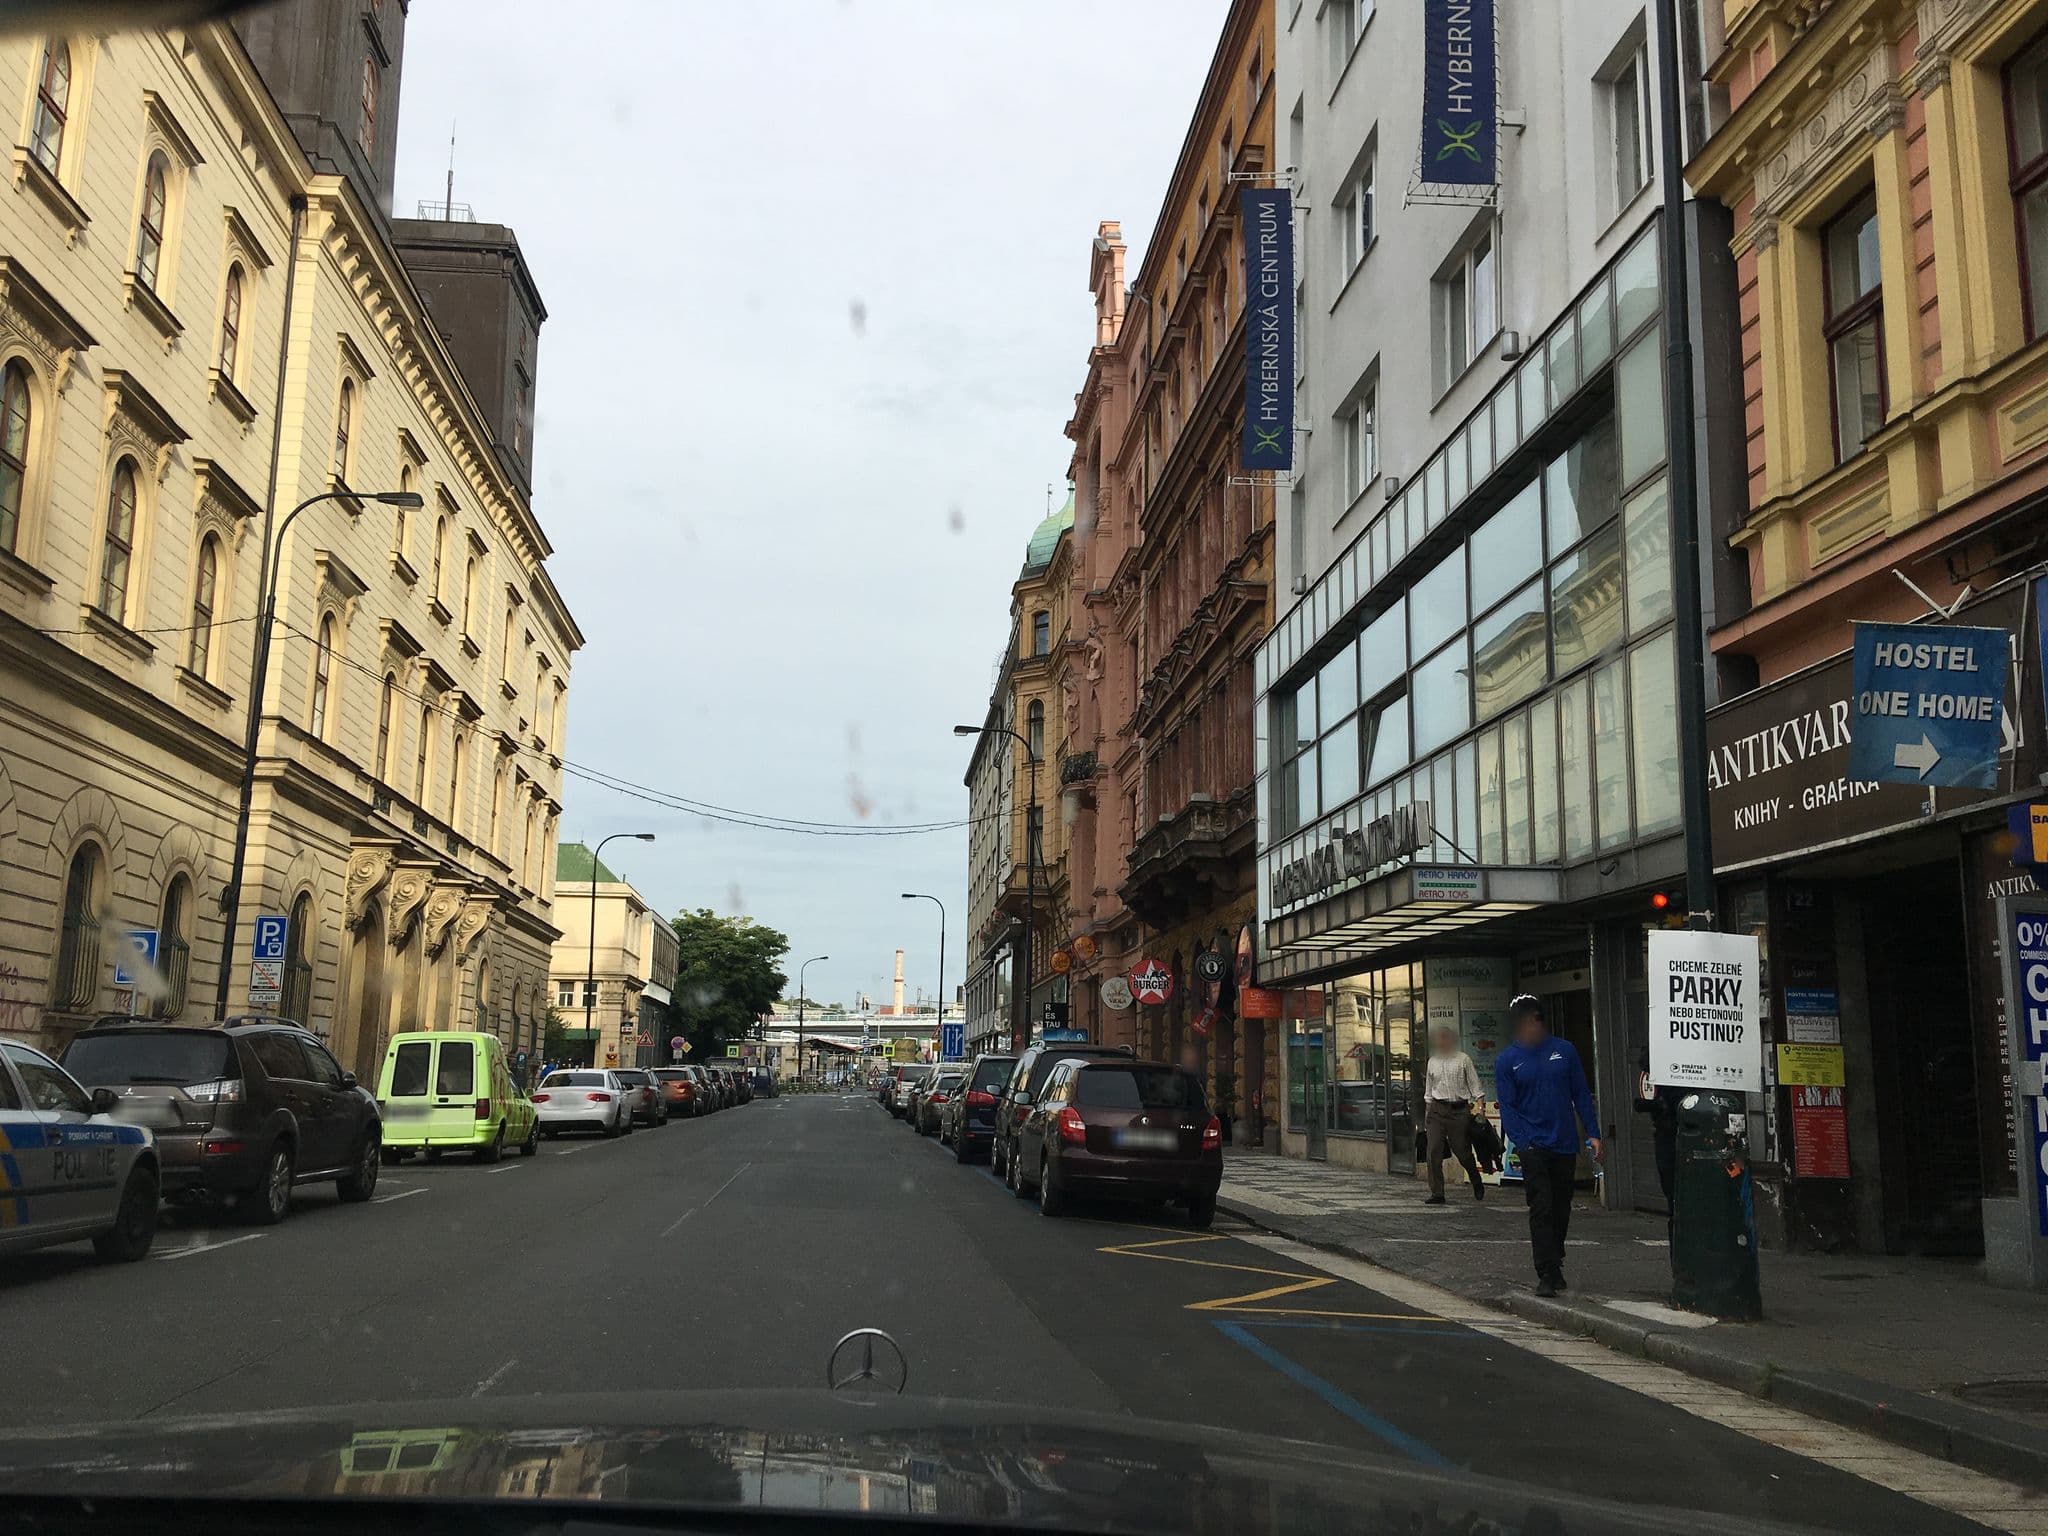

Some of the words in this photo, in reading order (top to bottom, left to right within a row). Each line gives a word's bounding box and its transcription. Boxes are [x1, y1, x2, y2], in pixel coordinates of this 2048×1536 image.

[1258, 202, 1279, 298] CENTRUM
[1257, 304, 1279, 421] HYBERNSKÁ
[1874, 642, 1979, 672] HOSTEL
[1859, 690, 1909, 716] ONE
[1917, 693, 1994, 721] HOME
[1734, 797, 1780, 830] KNIHY
[1418, 870, 1444, 879] RETRO
[1418, 889, 1445, 899] RETRO
[1448, 890, 1469, 899] TOYS
[261, 921, 281, 946] P
[1669, 960, 1709, 974] CHCEME
[1710, 962, 1742, 976] ZELENÉ
[1133, 980, 1170, 990] BURGER
[1669, 975, 1743, 1010] PARKY,
[1045, 1003, 1051, 1011] R
[1045, 1012, 1056, 1020] ES
[1669, 1006, 1693, 1018] NEBO
[1695, 1008, 1743, 1022] BETONOVOU
[1670, 1021, 1744, 1044] PUSTINU?
[53, 1148, 115, 1180] POLIE
